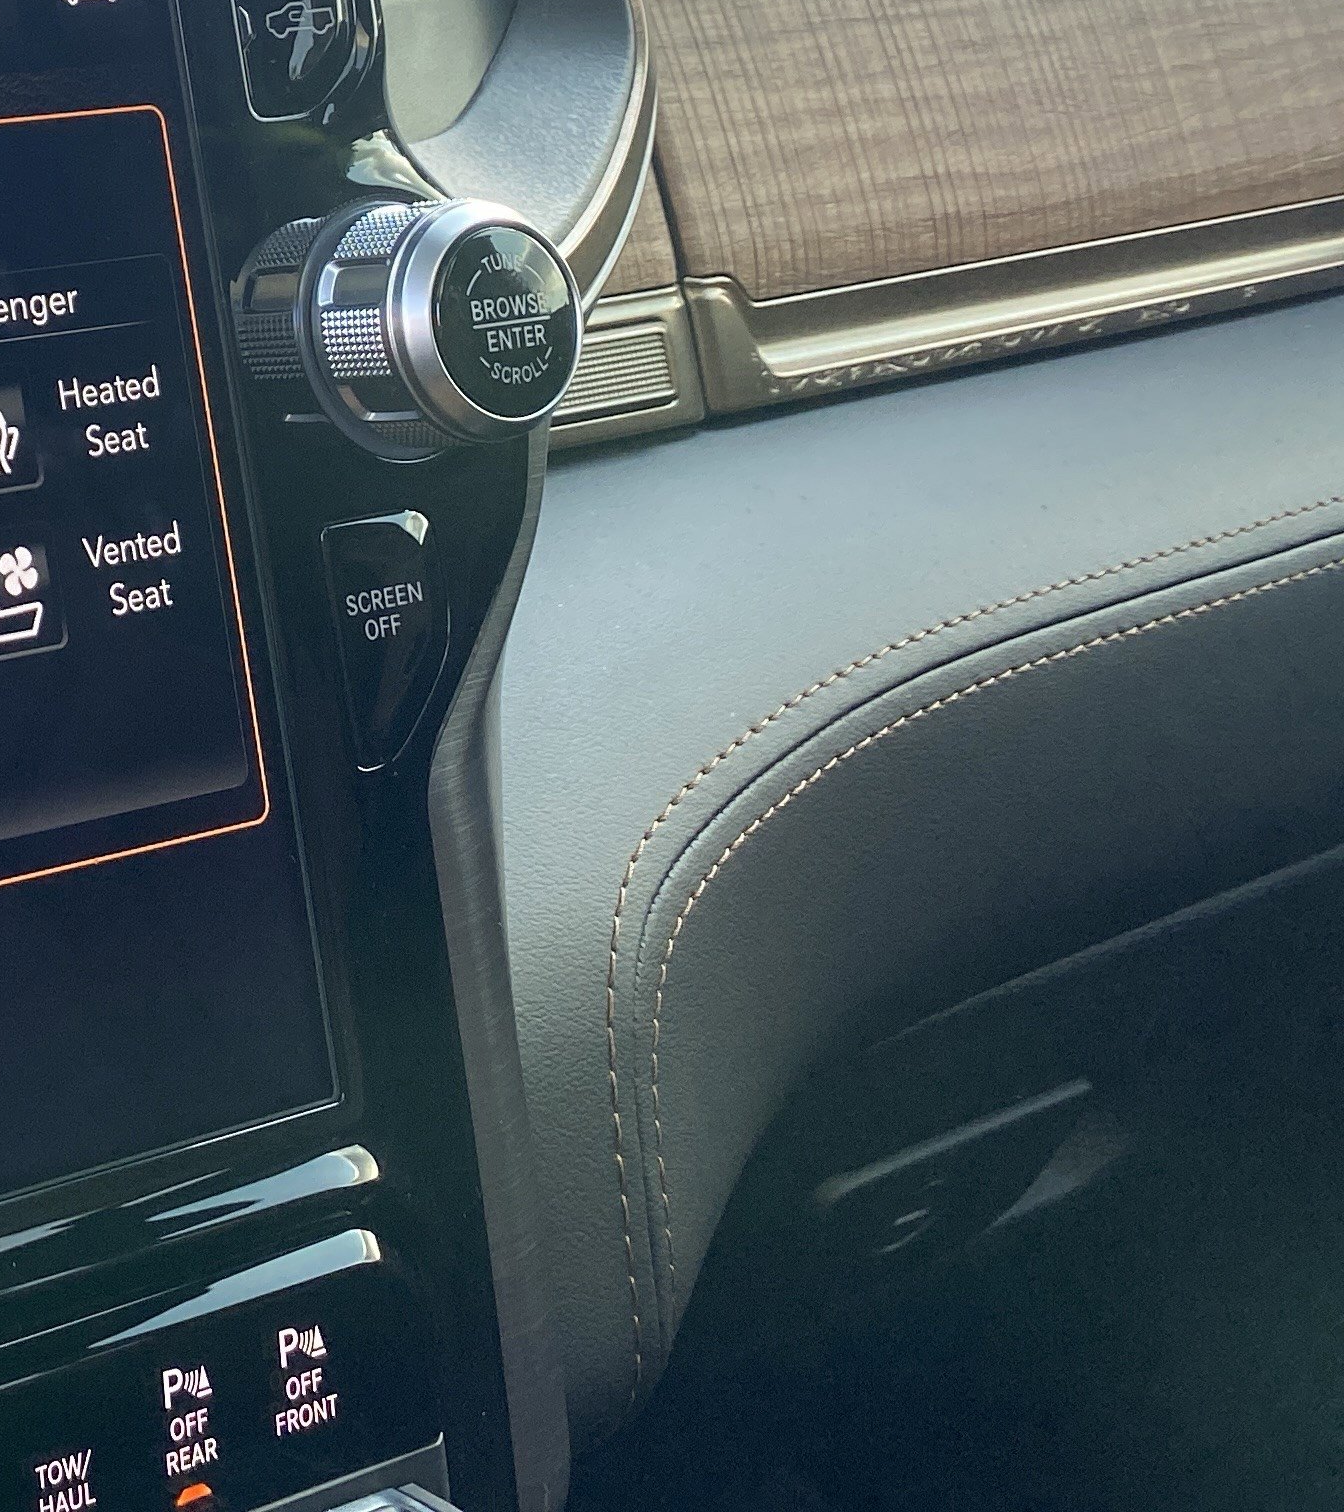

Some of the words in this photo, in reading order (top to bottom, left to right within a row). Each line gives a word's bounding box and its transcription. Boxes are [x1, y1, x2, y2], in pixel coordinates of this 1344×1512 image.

[470, 291, 549, 322] BROWSE
[486, 324, 547, 354] ENTER
[57, 363, 161, 411] Heated
[490, 357, 550, 386] SCROLL
[84, 419, 150, 459] Seat
[81, 520, 183, 570] Vented
[108, 575, 174, 618] Seat
[345, 581, 424, 617] SCREEN
[364, 614, 402, 642] OFF
[285, 1367, 323, 1402] OFF
[169, 1407, 209, 1441] OFF
[274, 1393, 339, 1437] FRONT
[34, 1448, 92, 1489] TOW/
[165, 1437, 218, 1477] REAR
[39, 1482, 97, 1512] HAUL
